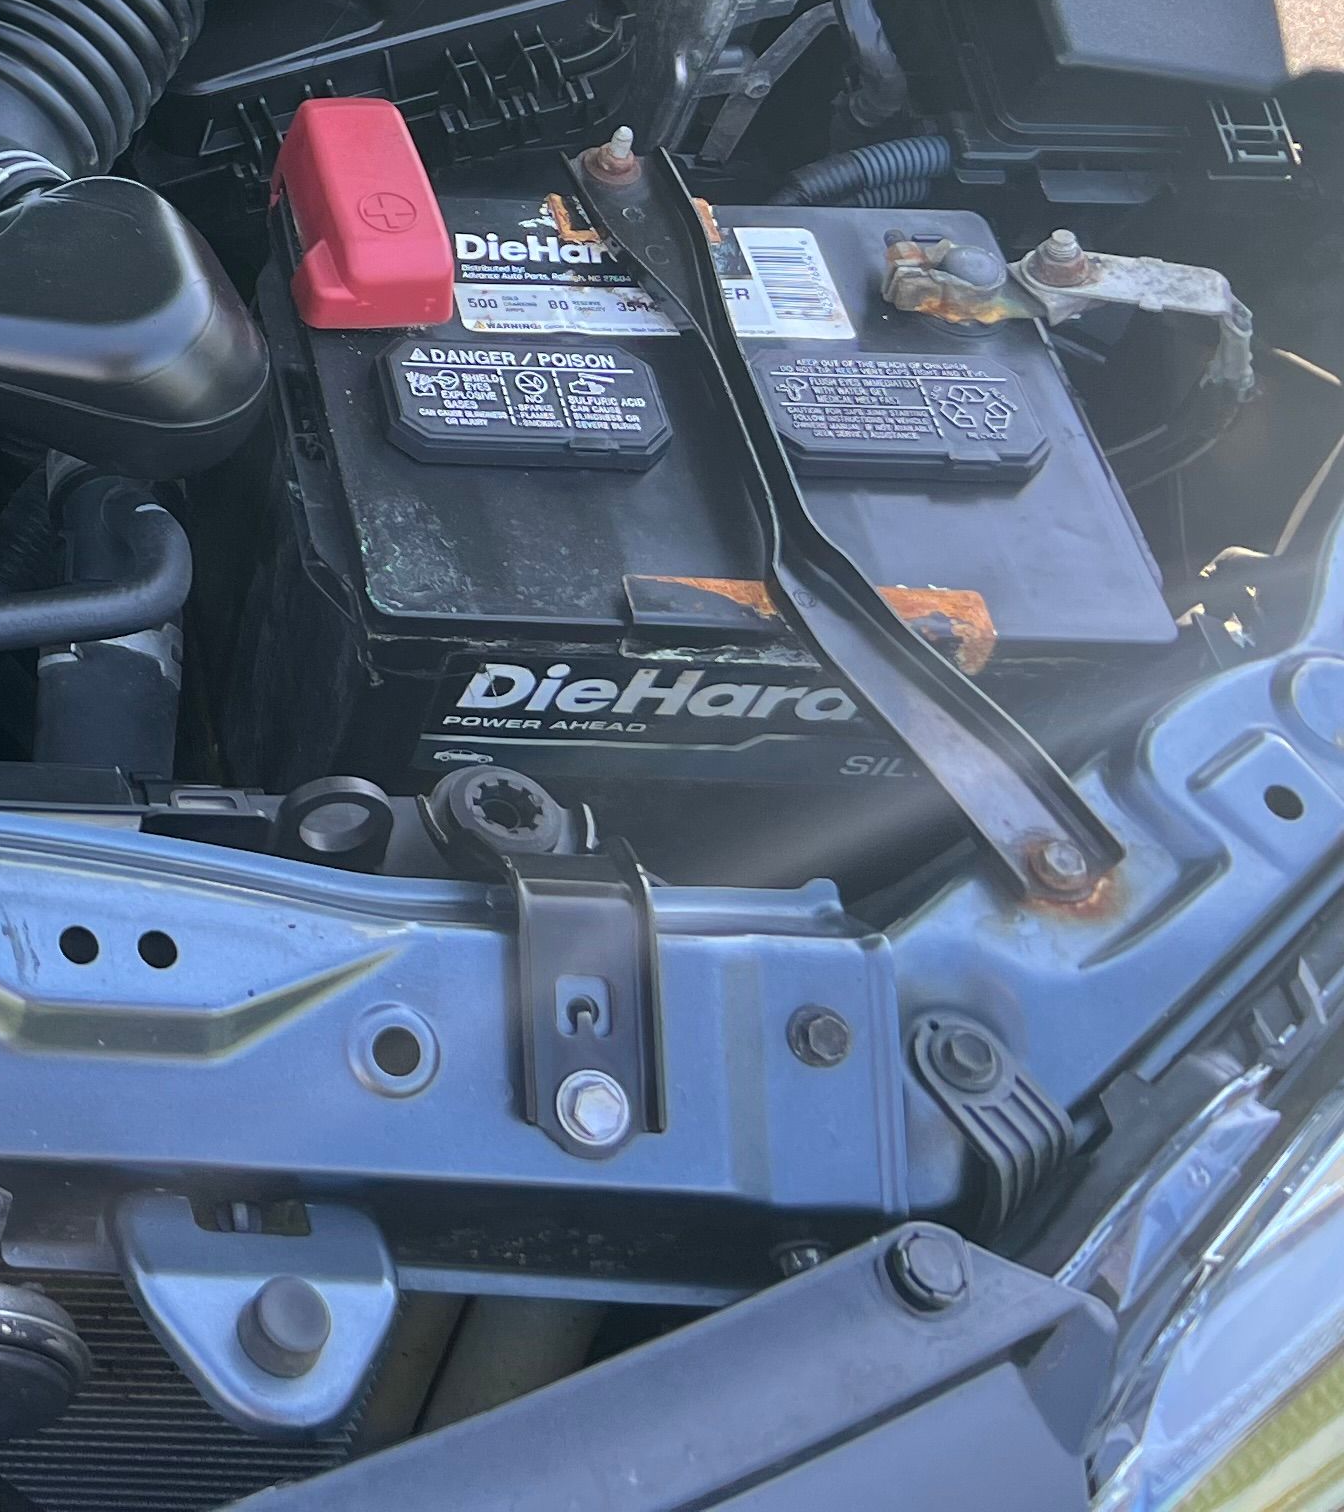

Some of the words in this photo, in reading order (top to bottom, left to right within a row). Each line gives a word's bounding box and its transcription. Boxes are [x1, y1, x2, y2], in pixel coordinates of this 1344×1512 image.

[455, 232, 607, 264] DieHar
[461, 264, 510, 273] Distributed
[462, 272, 500, 280] Advance
[467, 298, 498, 309] 500
[430, 348, 517, 366] DANGER
[537, 353, 616, 368] POISON
[461, 374, 499, 383] SHIELD
[464, 383, 492, 391] EYES
[441, 390, 498, 401] EXPLOSIVE
[525, 395, 544, 403] NO
[443, 400, 479, 409] GASES
[568, 395, 618, 406] SULFURIC
[621, 397, 646, 408] ACID
[442, 715, 543, 731] POWER
[554, 719, 649, 733] AHEAD
[839, 755, 919, 778] SIL
